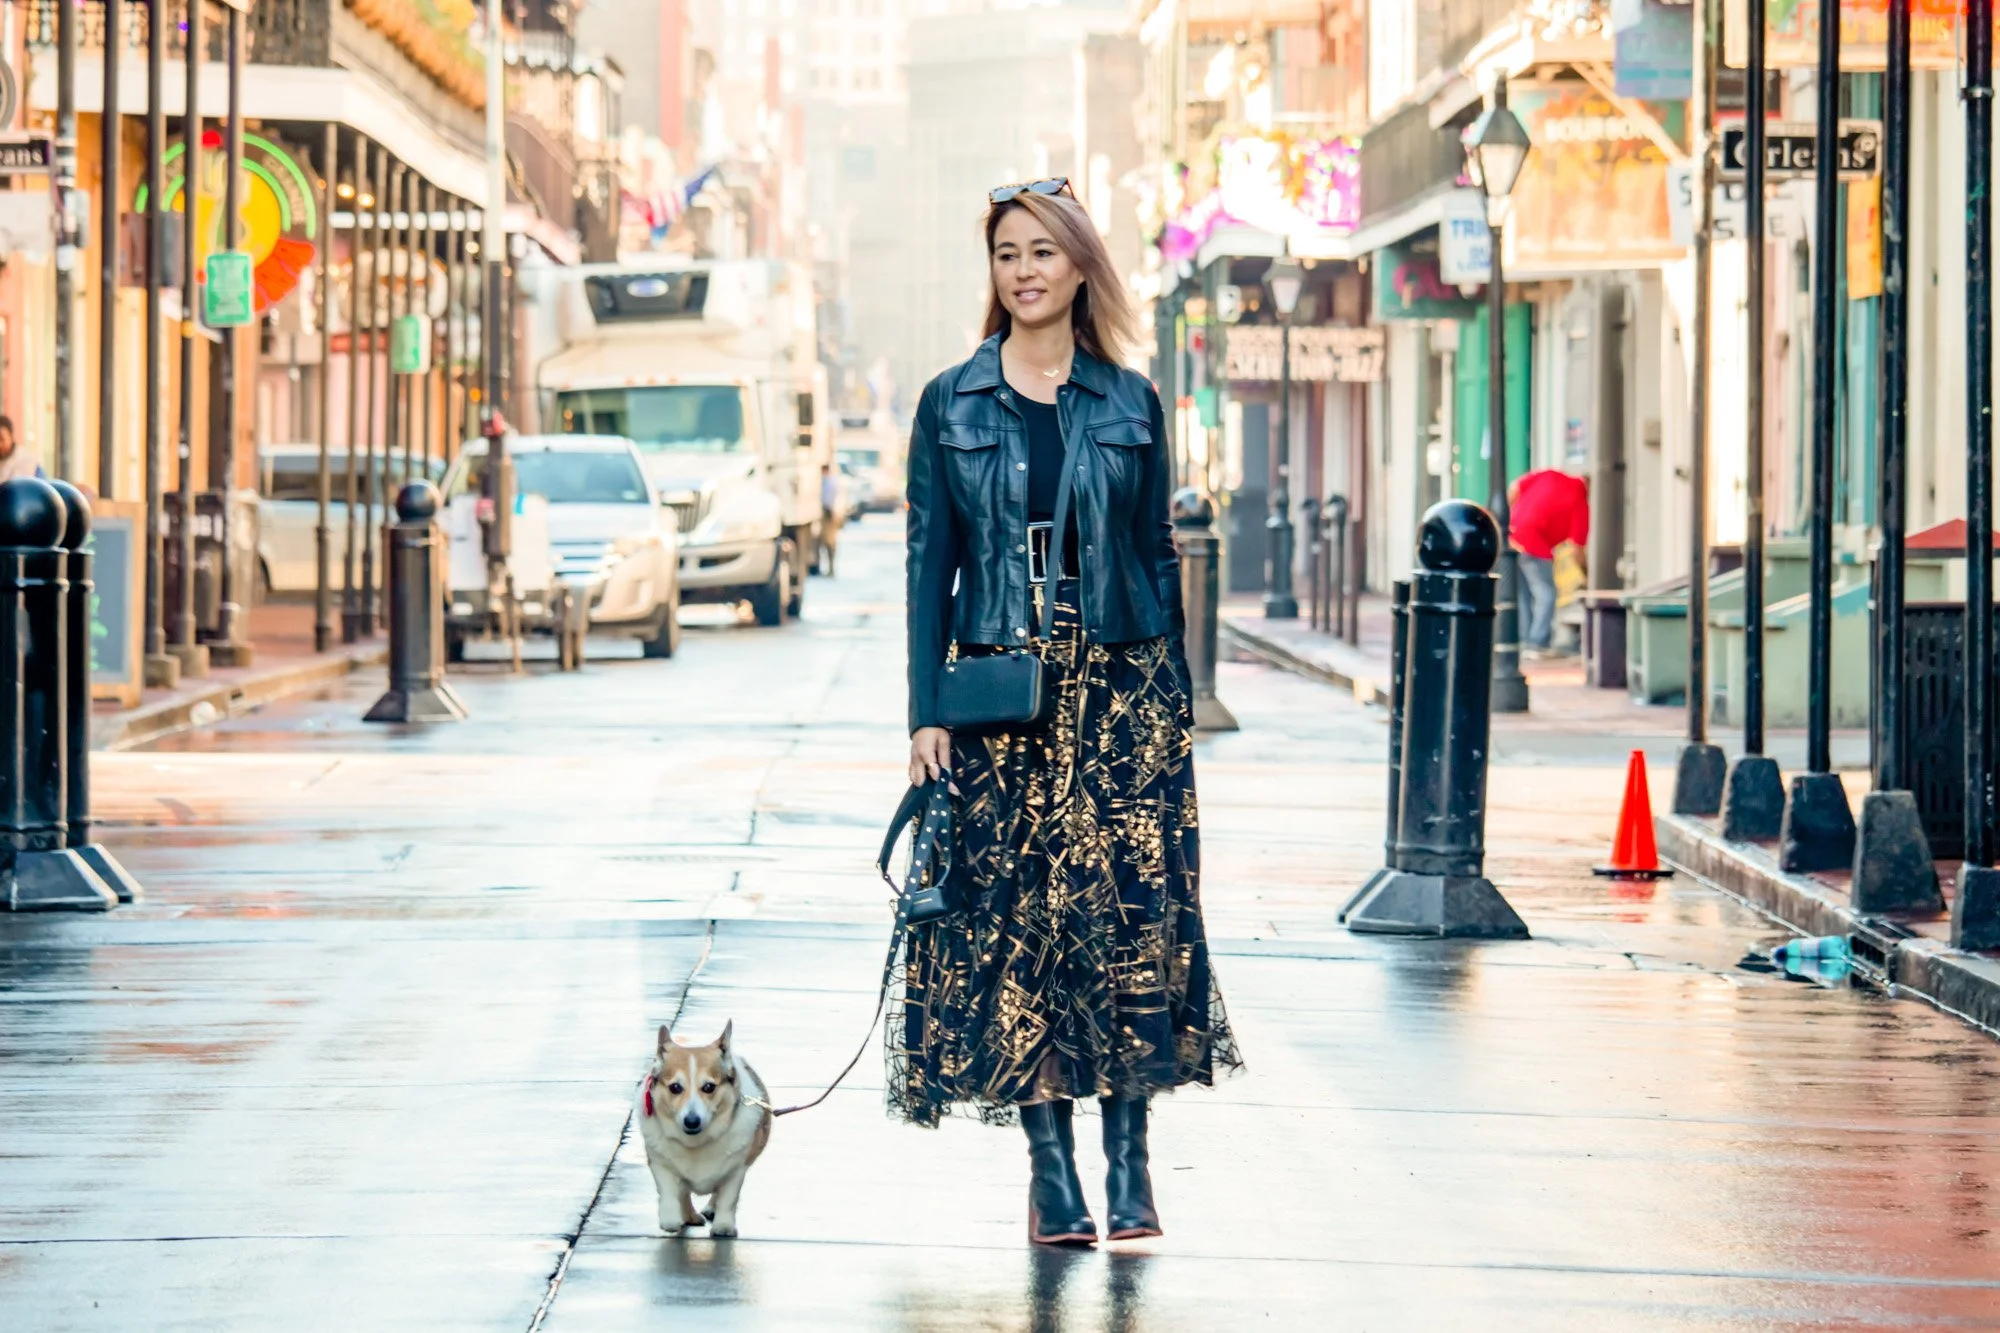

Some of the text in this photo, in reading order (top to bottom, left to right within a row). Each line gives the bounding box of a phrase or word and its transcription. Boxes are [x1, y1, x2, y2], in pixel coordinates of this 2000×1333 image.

[1545, 117, 1648, 141] BOURBO
[0, 148, 43, 166] ans
[1734, 136, 1866, 168] rlens
